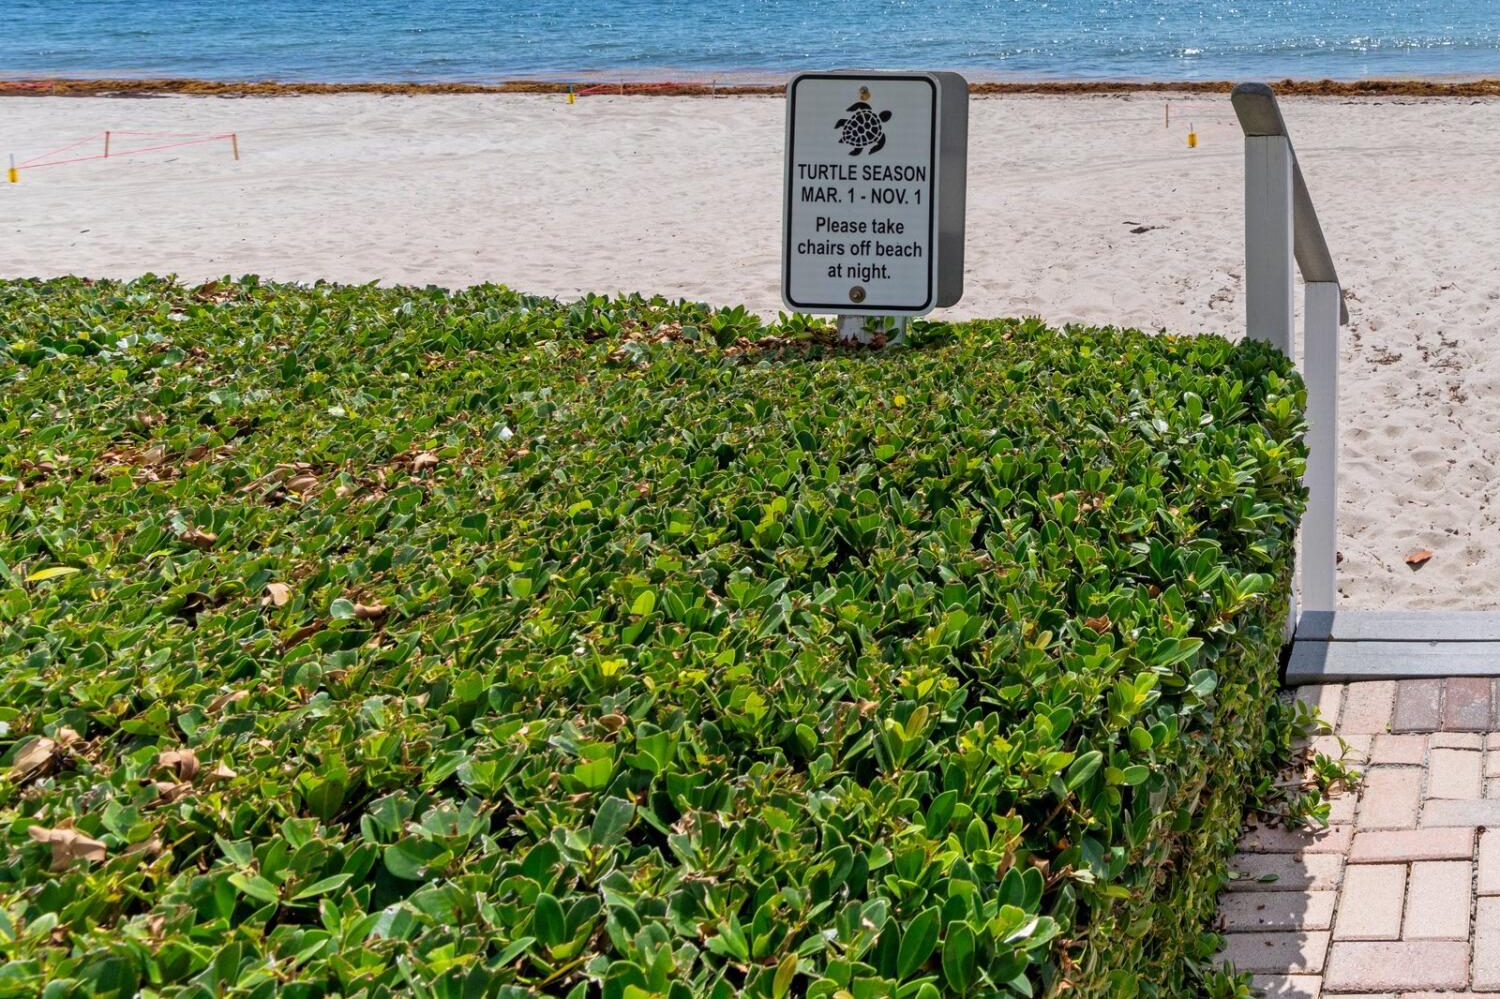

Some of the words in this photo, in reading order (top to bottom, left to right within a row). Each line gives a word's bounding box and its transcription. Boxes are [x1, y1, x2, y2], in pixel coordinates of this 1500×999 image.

[798, 164, 857, 181] TURTLE
[862, 165, 926, 182] SEASON
[801, 186, 842, 203] MAR.
[848, 188, 855, 203] 1
[871, 188, 909, 204] NOV.
[914, 189, 921, 205] 1
[815, 216, 867, 233] Please
[872, 218, 904, 234] take
[797, 239, 845, 256] chairs
[850, 240, 871, 256] off
[876, 241, 922, 258] beach
[827, 264, 842, 278] at
[847, 263, 891, 283] night.
